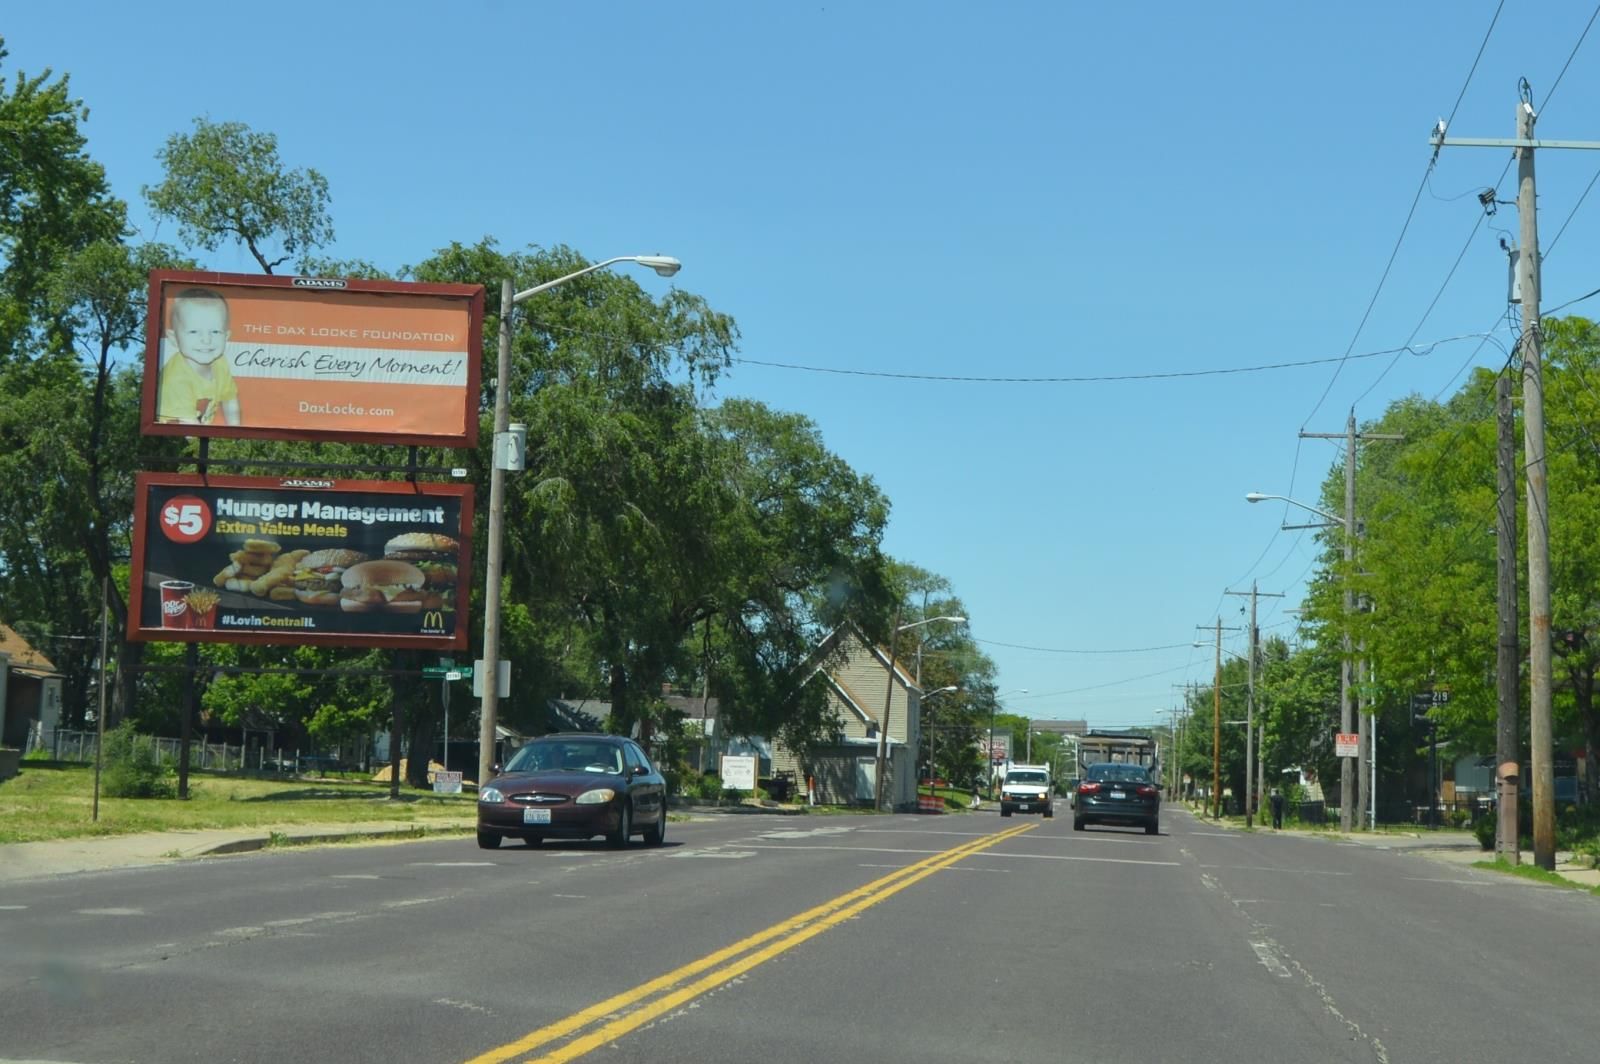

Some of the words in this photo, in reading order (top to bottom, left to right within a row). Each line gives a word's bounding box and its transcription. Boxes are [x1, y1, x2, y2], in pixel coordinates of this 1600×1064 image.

[296, 279, 344, 288] ADAMS
[243, 323, 272, 335] THE
[277, 325, 306, 336] DAX
[311, 327, 358, 338] LOCKE
[362, 329, 455, 343] FOUNDATION
[233, 348, 312, 369] Cherish
[313, 354, 367, 378] Every
[369, 356, 463, 376] Moment!
[299, 401, 394, 417] DaxLocke.com
[284, 479, 331, 488] ADAMS
[164, 504, 203, 536] $5
[216, 498, 298, 520] Hunger
[301, 501, 445, 525] Management
[216, 520, 256, 534] Extra
[259, 522, 301, 536] Value
[303, 523, 348, 538] Meals
[221, 615, 316, 628] #LovinCentralIL
